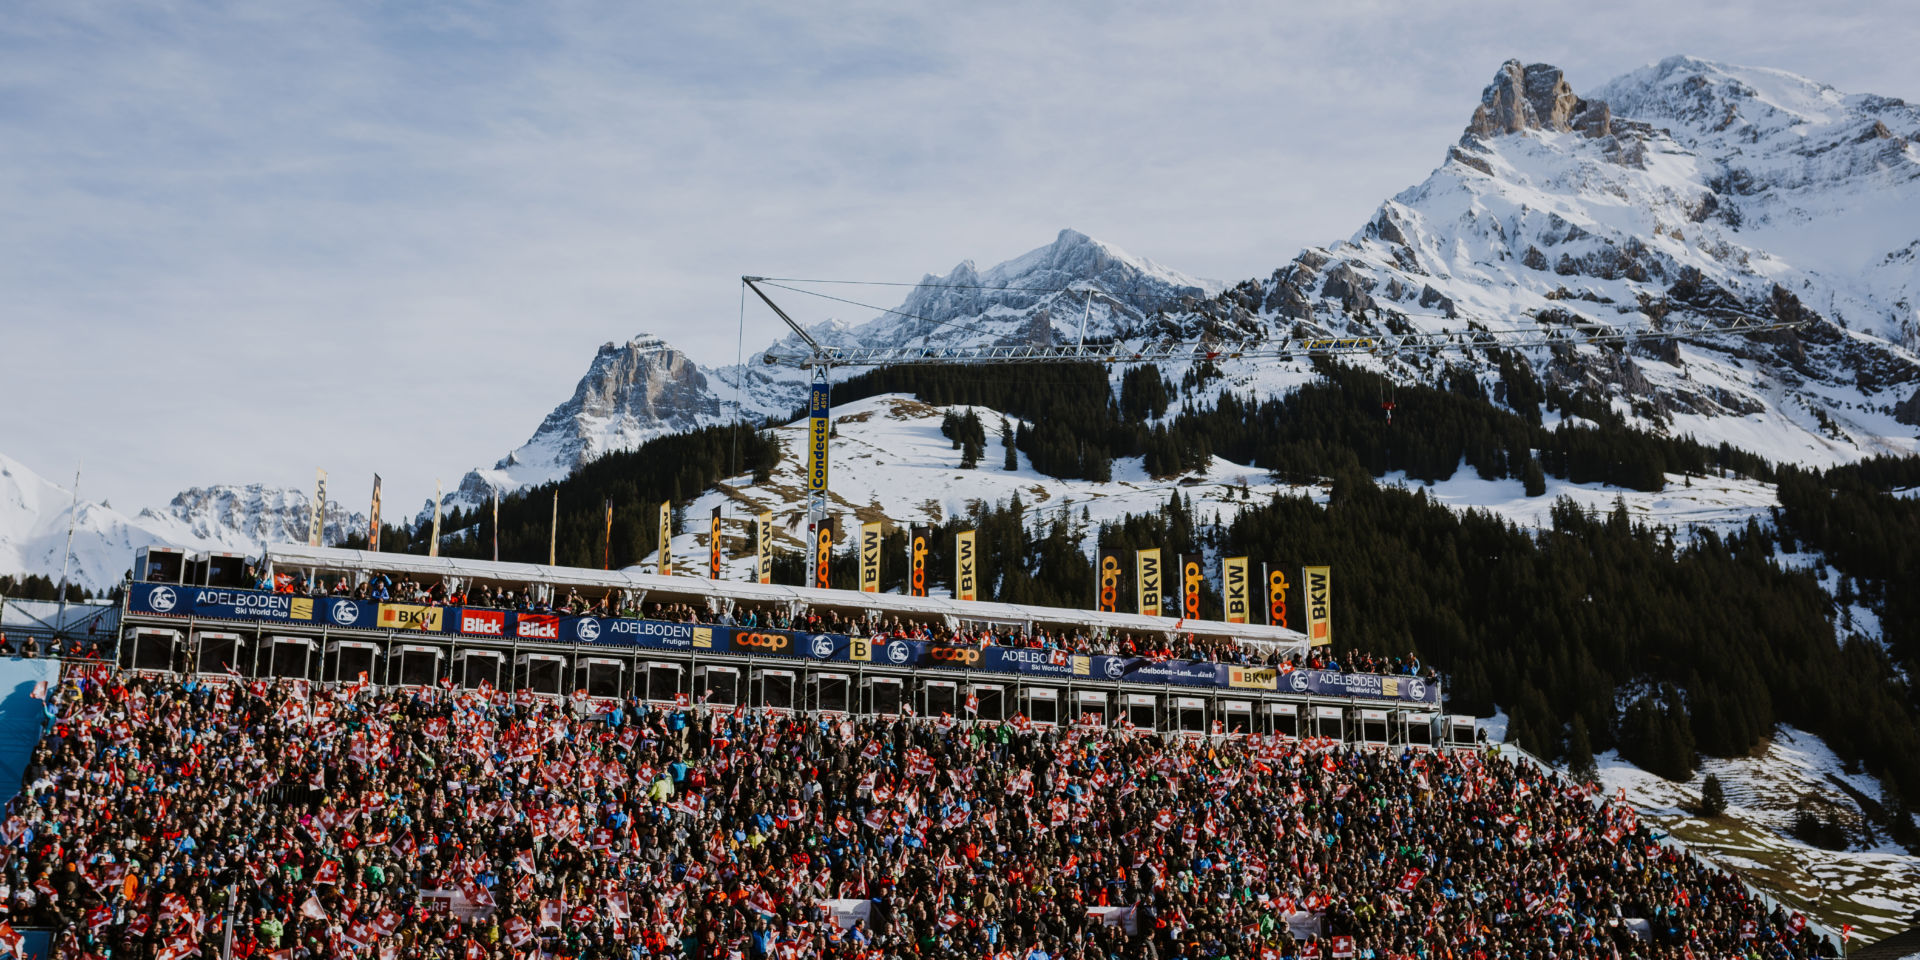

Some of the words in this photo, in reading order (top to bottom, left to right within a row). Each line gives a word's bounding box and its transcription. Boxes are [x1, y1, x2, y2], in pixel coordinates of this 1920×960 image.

[812, 419, 825, 488] Condecta
[663, 511, 671, 566] BKW
[761, 521, 770, 574] BKW
[864, 531, 878, 583] BKW
[961, 540, 972, 591] BKW
[1143, 557, 1158, 606] BKW
[1229, 565, 1244, 614] BKW
[196, 590, 289, 609] ADELBODEN
[1310, 573, 1326, 620] BKW
[234, 607, 247, 615] Ski
[248, 608, 270, 617] World
[271, 609, 288, 618] Cup
[398, 610, 437, 625] BKW
[463, 616, 502, 634] Blick
[518, 621, 556, 639] Blick
[610, 621, 691, 638] ADELBODEN
[662, 637, 690, 647] Frutigen
[736, 632, 788, 652] coop
[854, 641, 867, 657] B
[931, 647, 980, 665] coop
[1001, 650, 1072, 666] ADELBON
[1059, 666, 1072, 674] Cup
[1244, 672, 1273, 685] BKW
[1319, 673, 1381, 688] ADELBODEN
[1370, 688, 1382, 696] Cup
